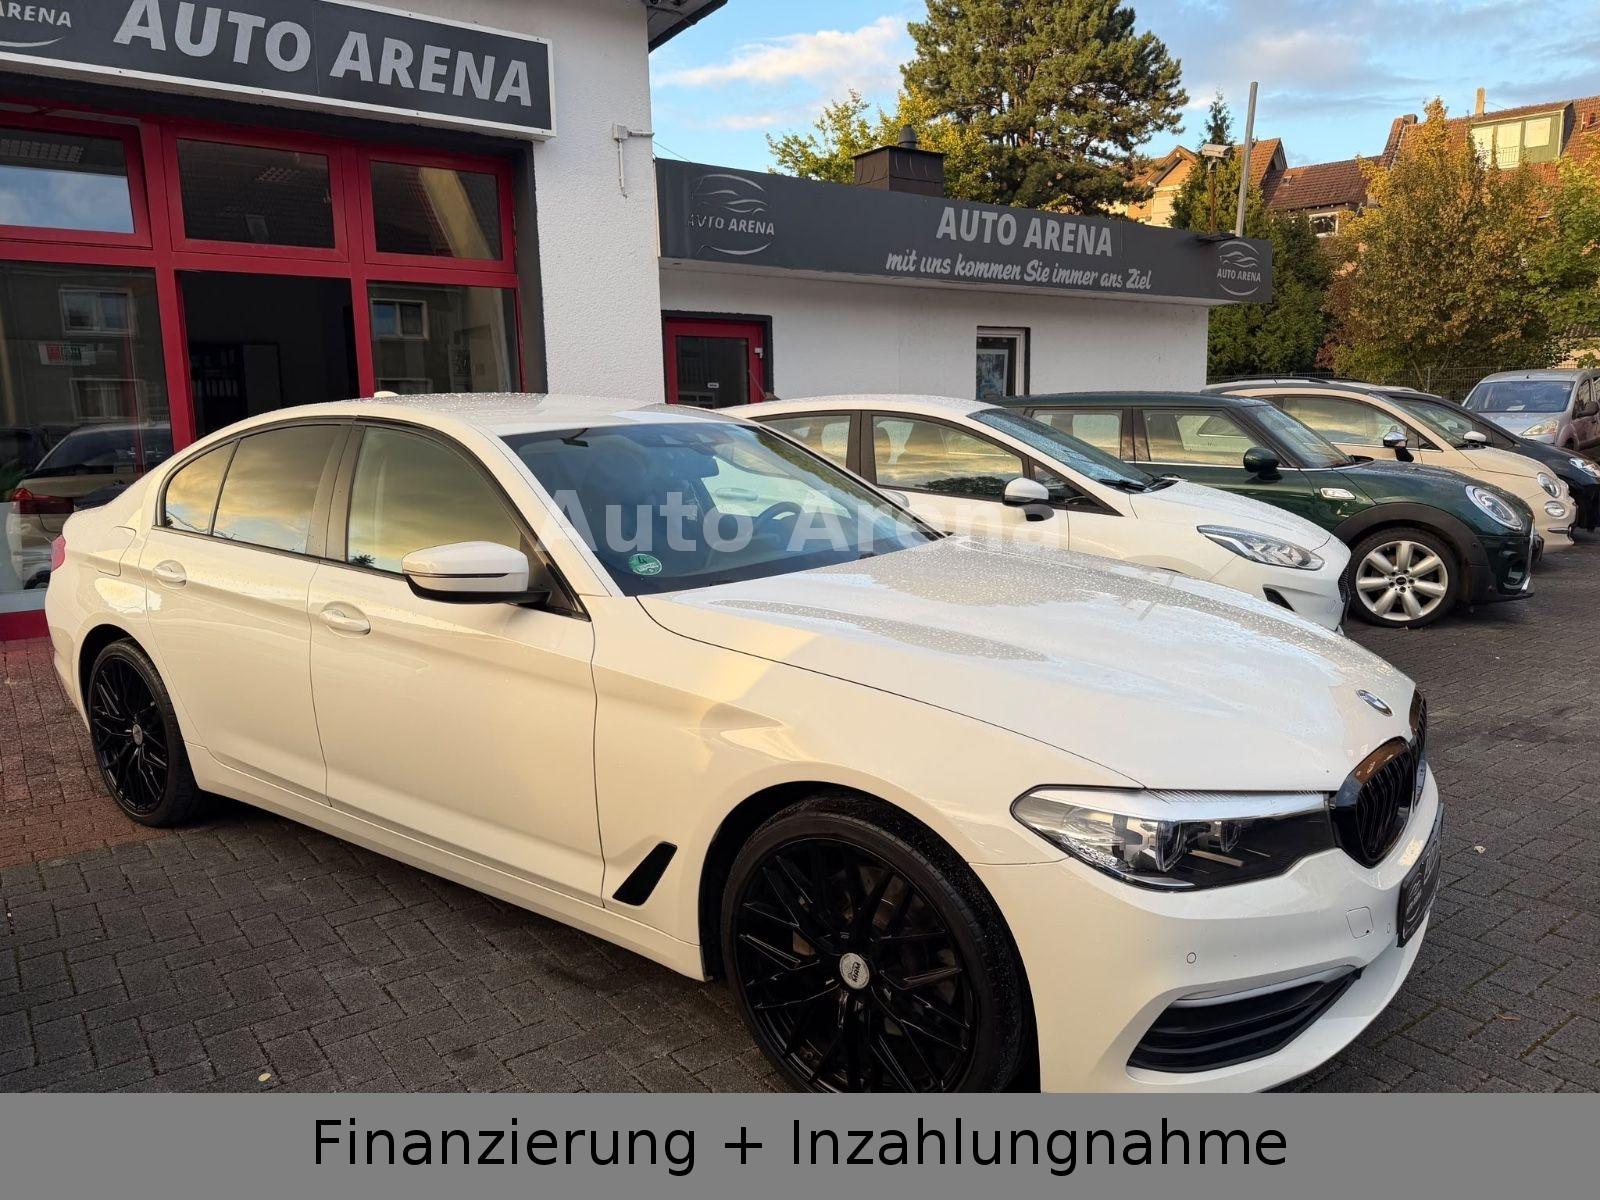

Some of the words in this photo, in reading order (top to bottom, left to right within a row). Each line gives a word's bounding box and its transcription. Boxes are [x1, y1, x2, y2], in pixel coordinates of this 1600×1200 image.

[113, 0, 312, 72] AUTO
[329, 30, 532, 107] ARENA
[728, 218, 775, 235] ARENA
[936, 206, 1017, 246] AUTO
[1023, 217, 1113, 257] ARENA
[885, 249, 917, 272] mit
[920, 256, 951, 274] uns
[954, 252, 1021, 280] kommen
[1023, 259, 1050, 282] Sie
[1052, 262, 1098, 286] immer
[1100, 271, 1123, 288] ans
[1126, 268, 1152, 289] Ziel
[1217, 268, 1236, 279] AUTO
[1237, 270, 1261, 282] ARENA
